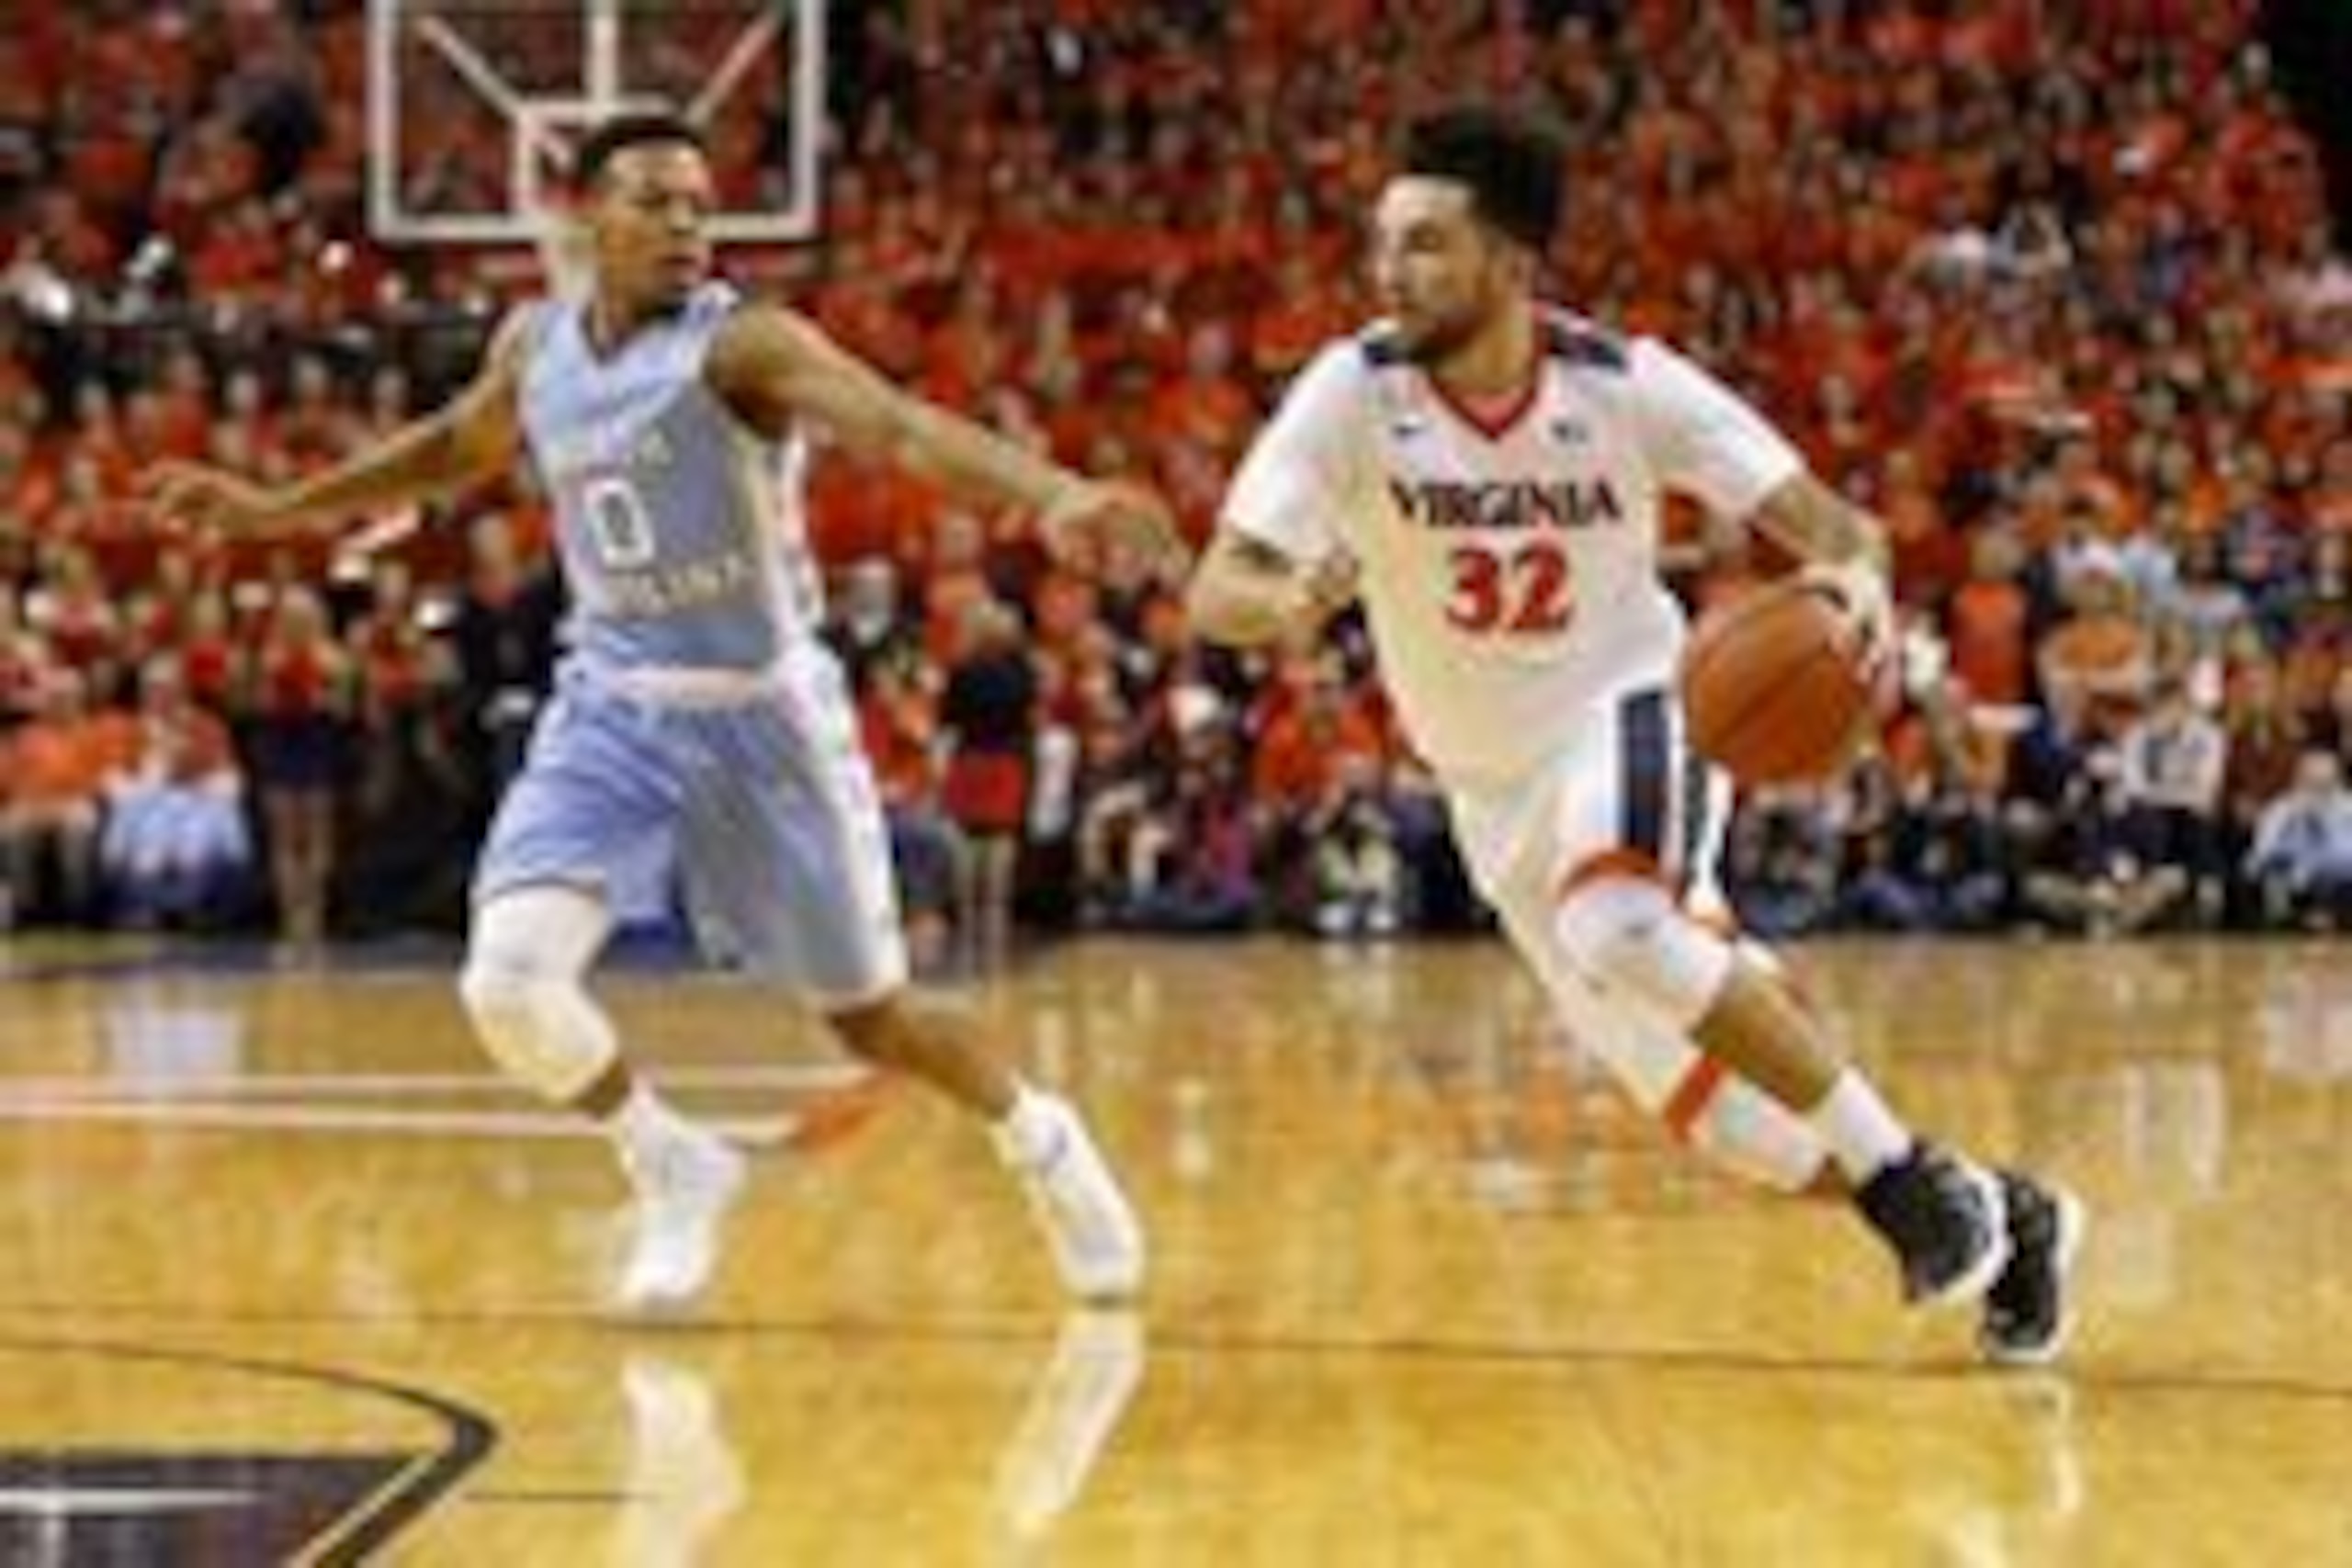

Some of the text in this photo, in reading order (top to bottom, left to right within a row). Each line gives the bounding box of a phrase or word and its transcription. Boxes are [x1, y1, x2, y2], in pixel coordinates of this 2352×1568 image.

[583, 478, 655, 567] 0
[1387, 476, 1622, 528] VIRGINIA
[1445, 545, 1575, 631] 32
